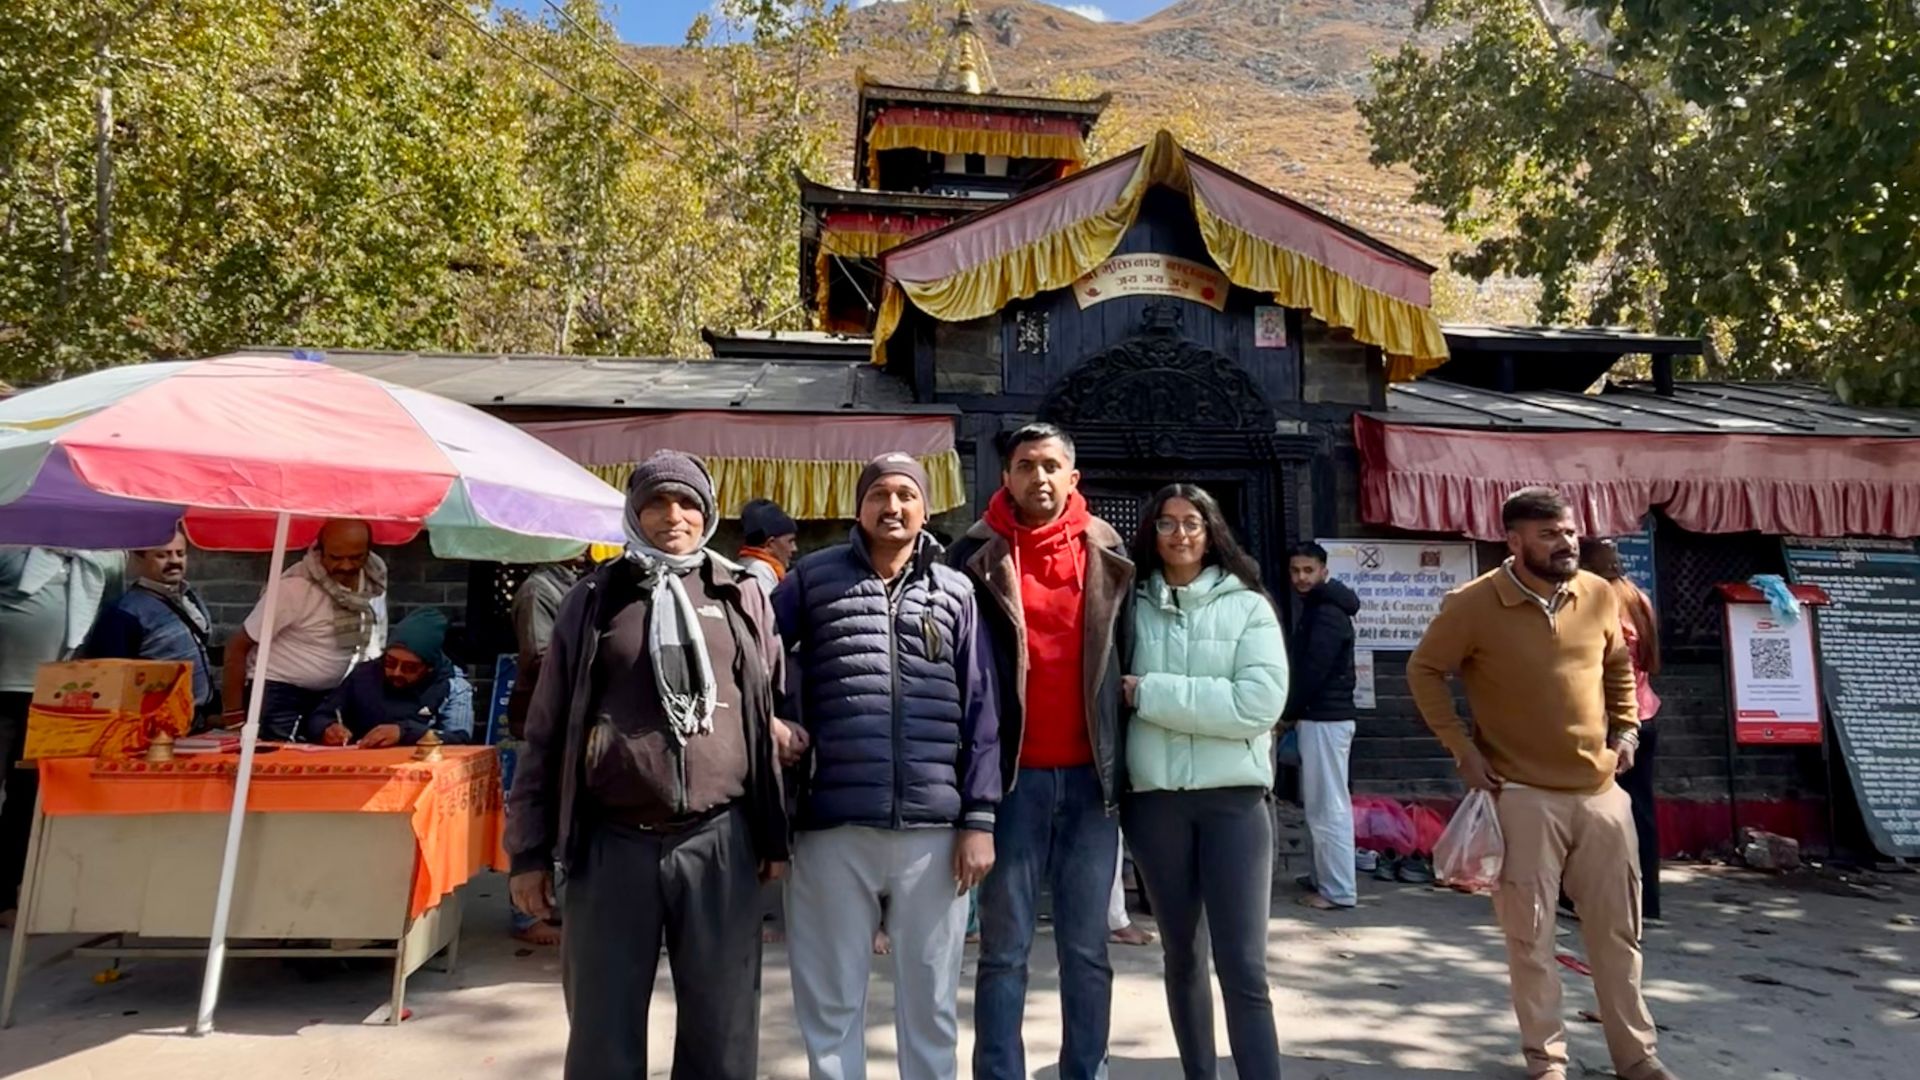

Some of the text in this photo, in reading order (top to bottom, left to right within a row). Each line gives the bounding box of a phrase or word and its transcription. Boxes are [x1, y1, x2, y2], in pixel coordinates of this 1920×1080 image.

[1116, 274, 1137, 286] जय
[1143, 274, 1164, 285] जय
[1168, 277, 1189, 289] जय
[1381, 600, 1389, 611] &
[1393, 600, 1434, 611] Cameras
